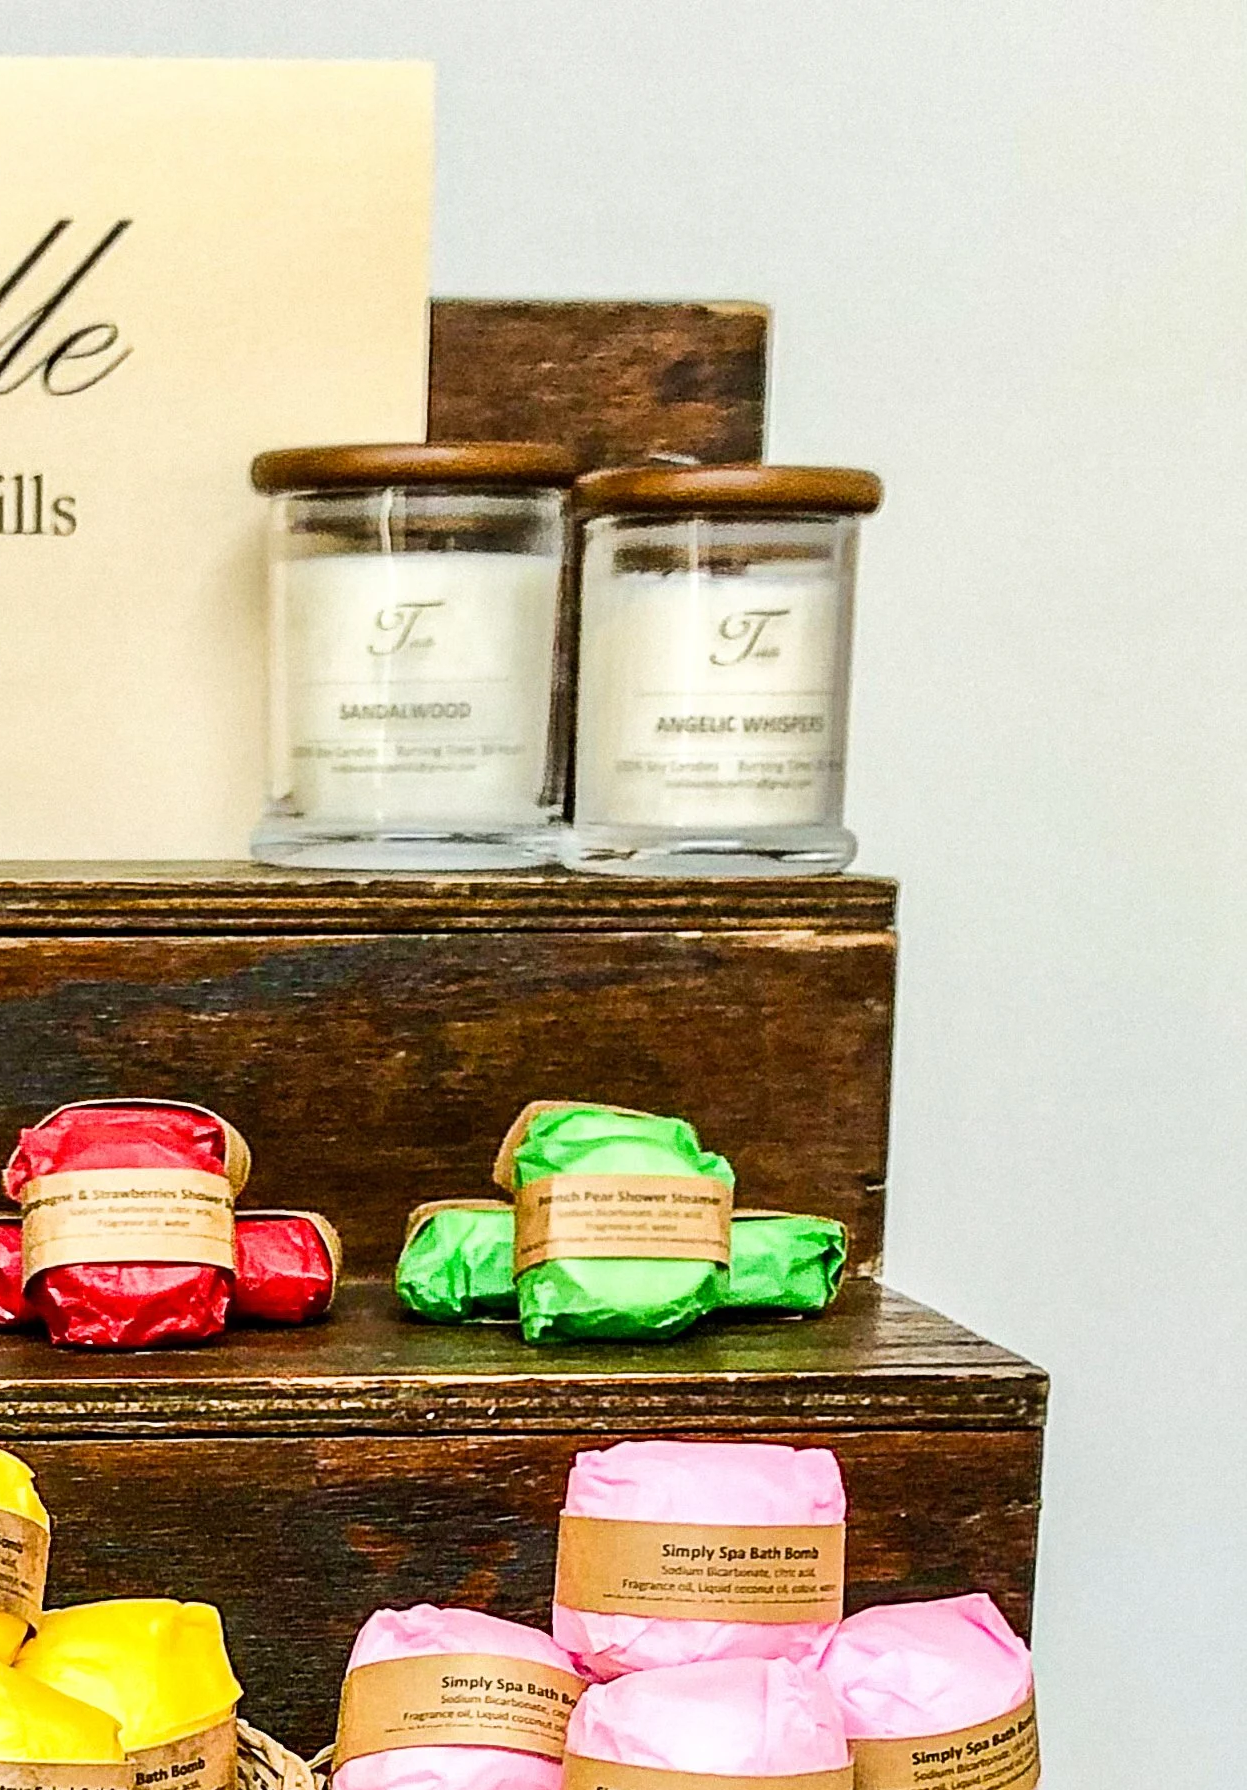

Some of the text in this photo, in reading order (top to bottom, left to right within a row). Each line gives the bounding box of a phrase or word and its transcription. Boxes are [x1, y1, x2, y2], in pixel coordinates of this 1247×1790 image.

[339, 702, 472, 720] SANDALWOOD
[656, 715, 738, 733] ANGELIC
[92, 1188, 178, 1200] Strawberries
[584, 1191, 614, 1202] Pear
[618, 1191, 666, 1202] Shower
[662, 1544, 819, 1562] Simply Spa Bath Bomb
[622, 1578, 675, 1593] Fragrance
[698, 1582, 731, 1595] Liquid
[441, 1676, 577, 1707] Simply Spa Bath Bo
[441, 1695, 481, 1705] Sodium
[403, 1710, 454, 1722] Fragrance
[477, 1709, 510, 1721] Liquid
[912, 1725, 1016, 1766] Simply Spa Bath
[135, 1756, 205, 1785] Bath Bomb
